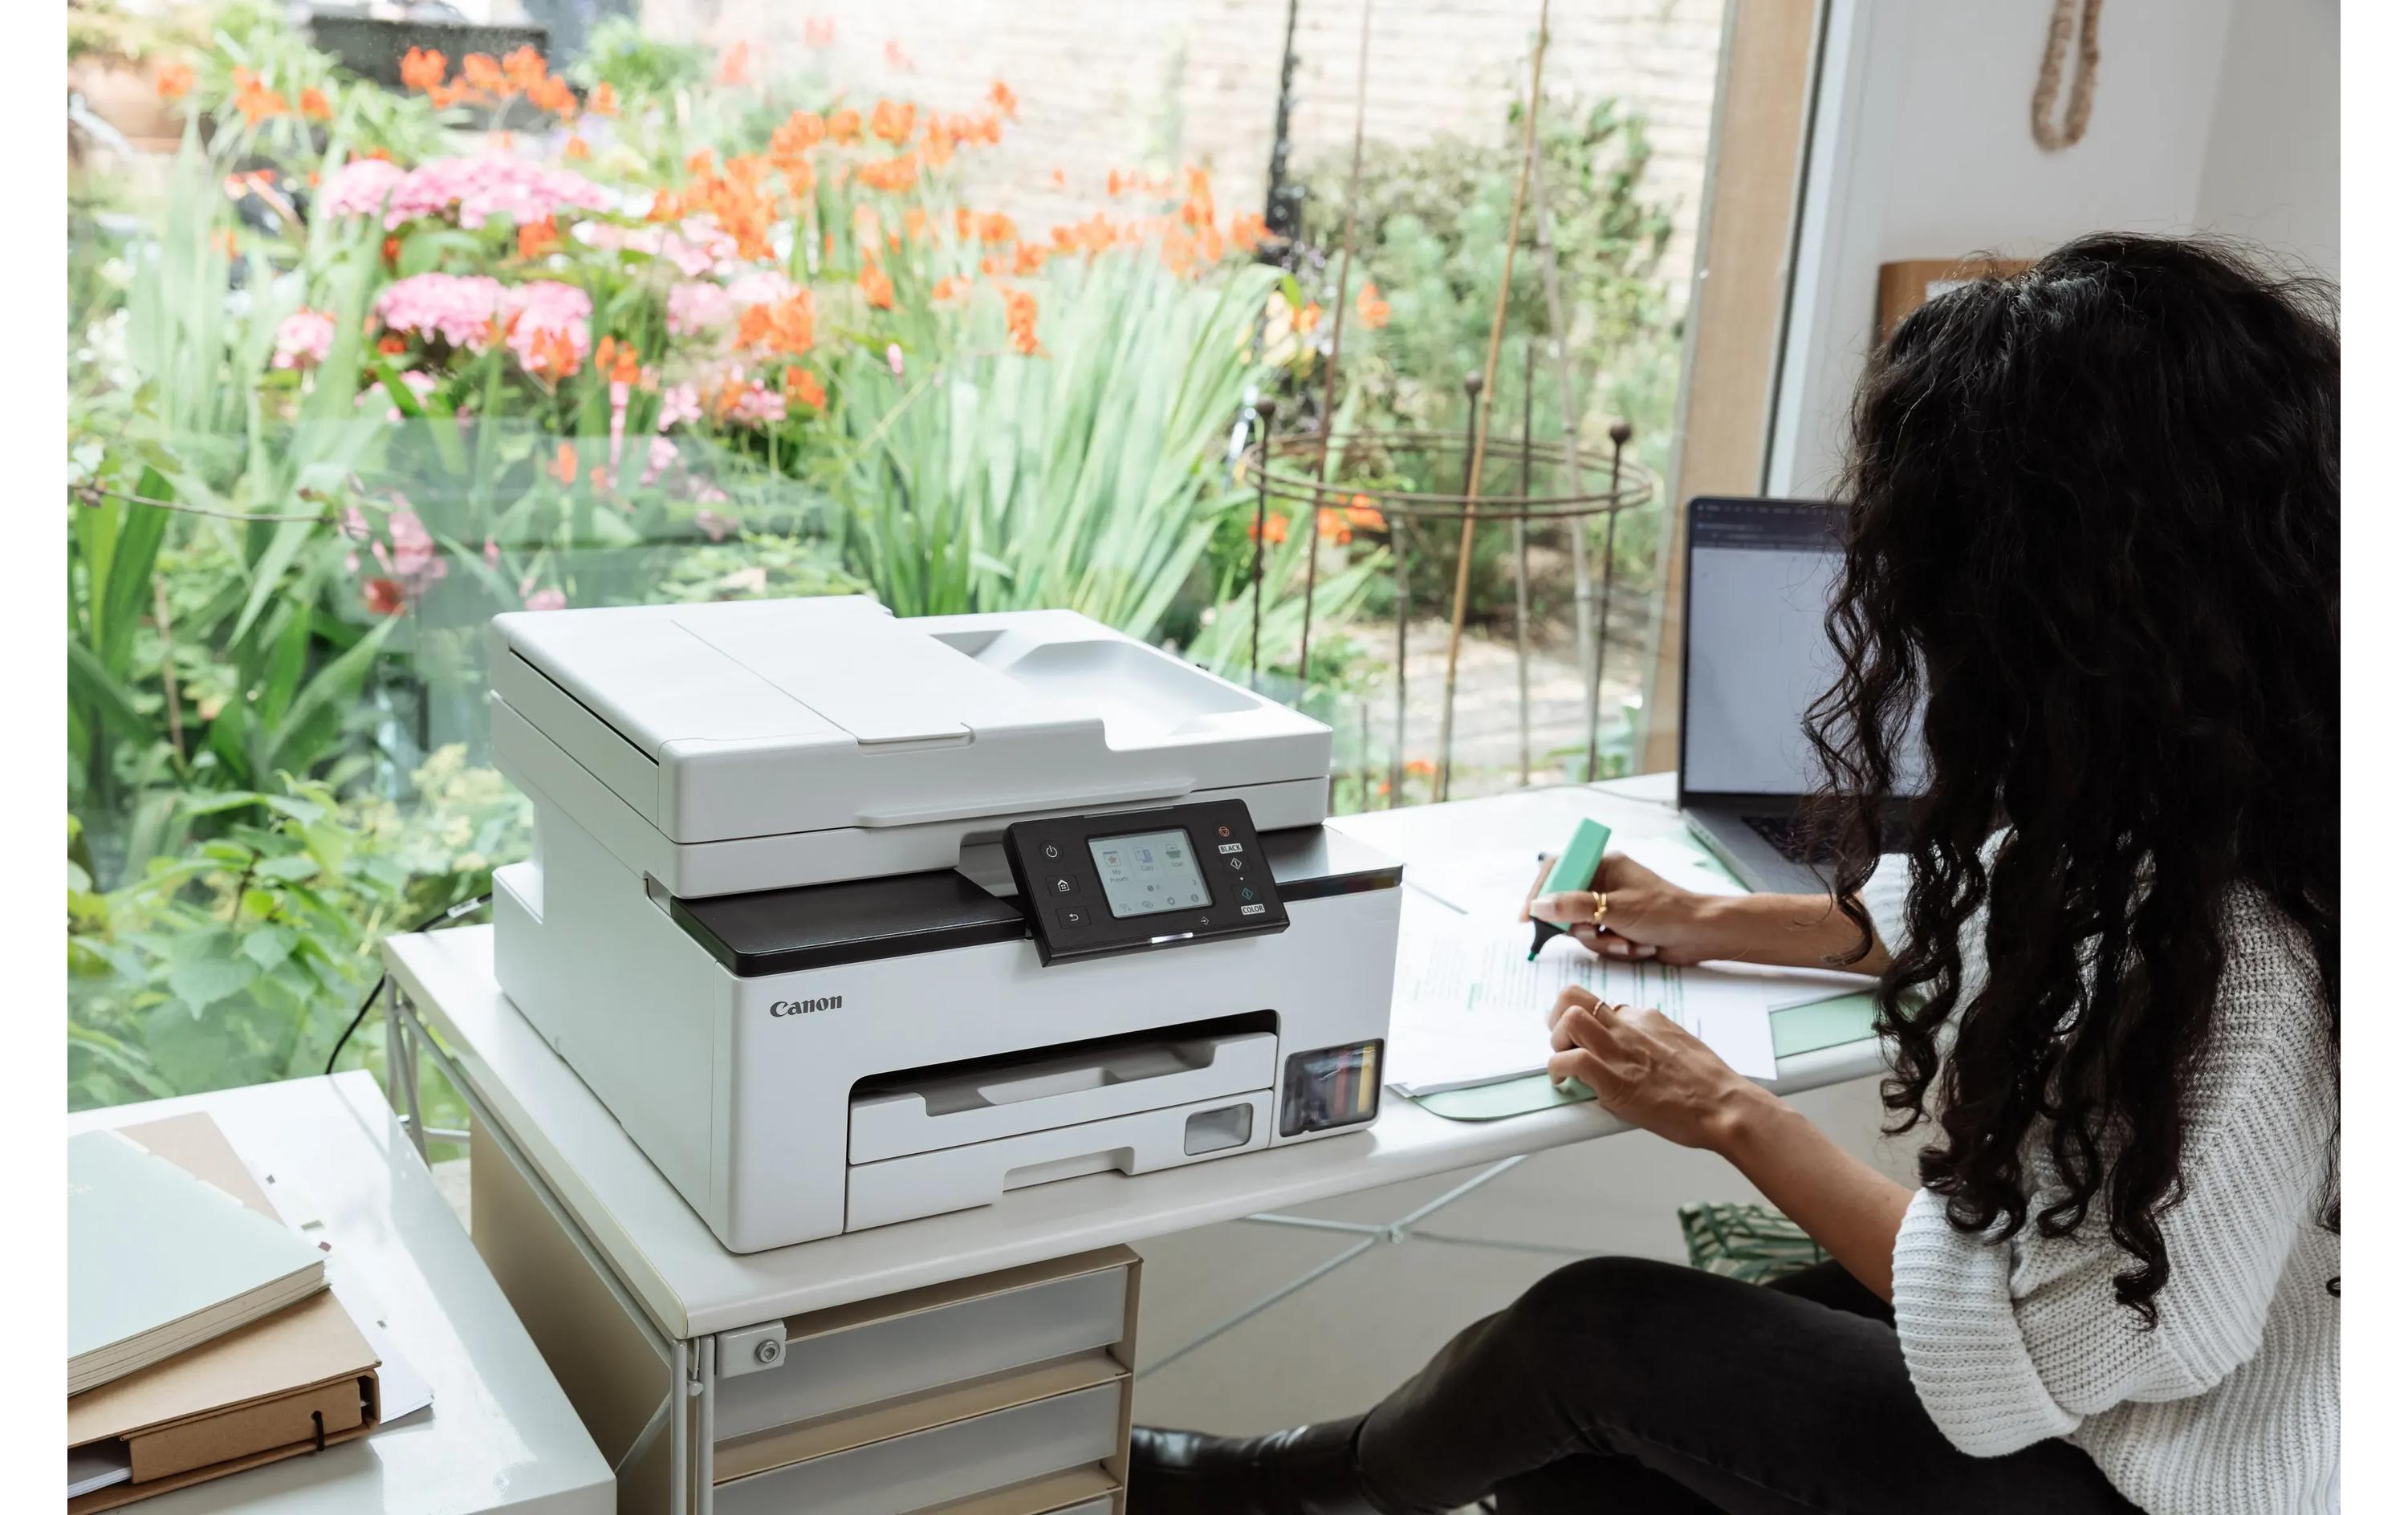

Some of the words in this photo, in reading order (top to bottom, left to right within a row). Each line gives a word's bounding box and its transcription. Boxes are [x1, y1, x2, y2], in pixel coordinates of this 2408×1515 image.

[1219, 844, 1242, 853] BLACK
[1242, 905, 1264, 914] COLOR
[770, 995, 842, 1017] Canon
